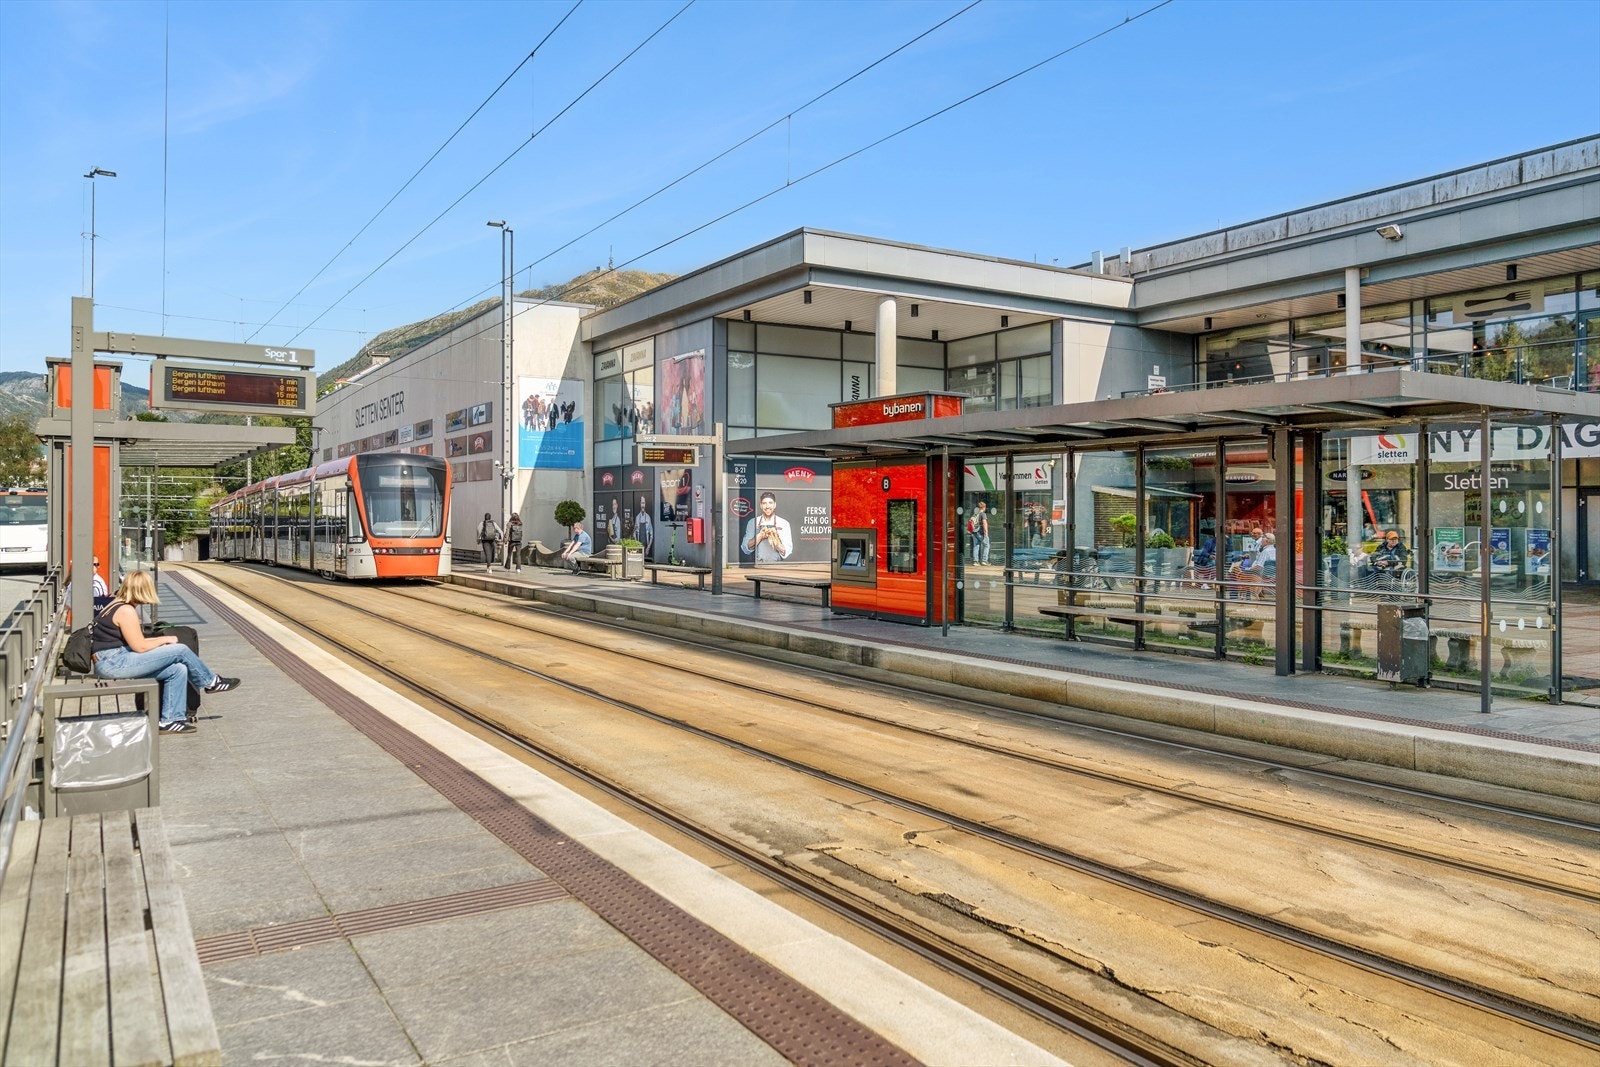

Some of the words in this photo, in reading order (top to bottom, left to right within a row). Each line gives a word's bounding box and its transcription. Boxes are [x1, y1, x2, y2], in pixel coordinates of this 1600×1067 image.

[264, 347, 288, 359] Spor
[288, 350, 299, 363] 1
[172, 370, 197, 380] Bergen
[198, 372, 226, 381] lufthavn
[172, 377, 197, 387] Bergen
[198, 379, 226, 388] lufthavn
[851, 375, 860, 401] ANNA
[172, 384, 197, 394] Bergen
[198, 386, 226, 395] lufthavn
[355, 401, 379, 429] SLETTEN
[379, 390, 405, 421] SENTER
[883, 402, 922, 417] bybanen
[1378, 450, 1408, 459] sletten
[787, 469, 812, 480] MENY
[806, 506, 827, 515] FERSK
[803, 516, 818, 525] FISK
[819, 516, 829, 525] OG
[800, 526, 832, 534] SKALLDYR
